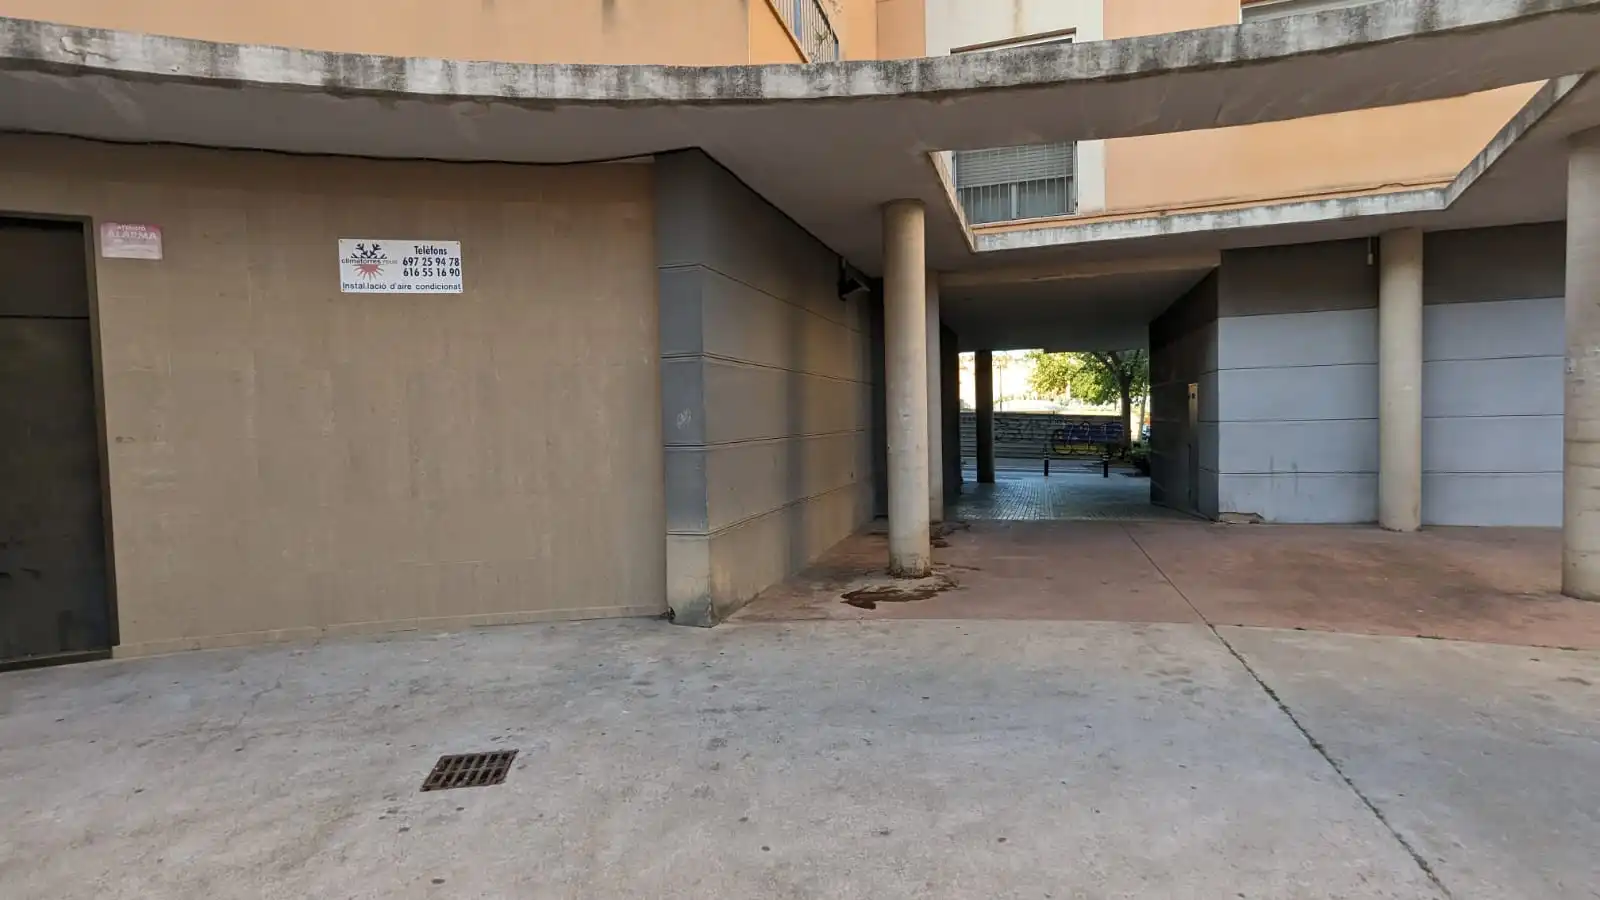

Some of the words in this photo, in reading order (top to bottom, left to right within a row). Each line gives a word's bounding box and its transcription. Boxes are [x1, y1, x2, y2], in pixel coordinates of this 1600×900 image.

[108, 229, 157, 240] ALARMA
[414, 245, 448, 255] Telèfons
[402, 257, 419, 267] 697
[422, 257, 433, 267] 25
[435, 257, 446, 267] 94
[449, 257, 460, 267] 78
[403, 267, 420, 277] 616
[422, 268, 433, 277] 55
[436, 268, 447, 277] 16
[449, 268, 461, 277] 90
[390, 282, 412, 290] d'aire
